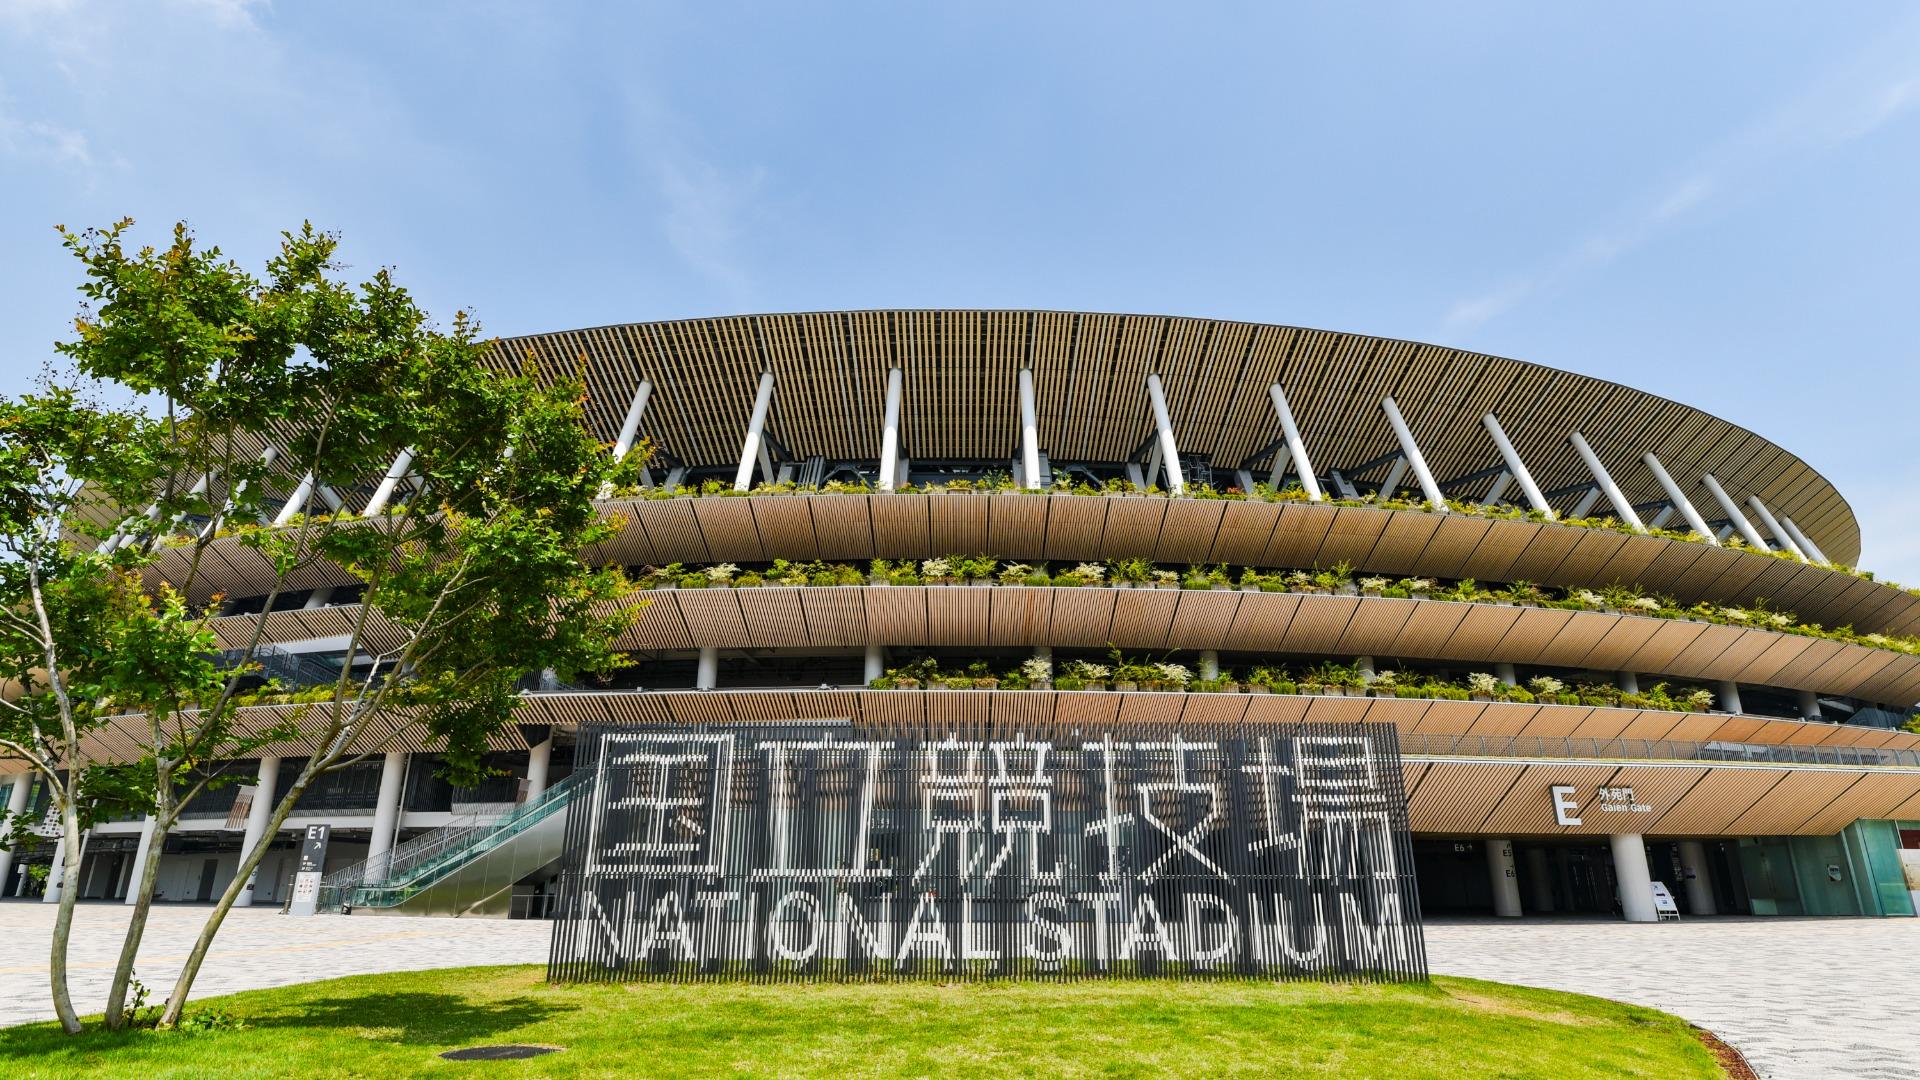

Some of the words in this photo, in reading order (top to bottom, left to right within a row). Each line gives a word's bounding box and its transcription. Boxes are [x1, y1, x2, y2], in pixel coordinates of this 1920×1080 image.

[1599, 787, 1635, 801] 外苑門
[1552, 785, 1582, 825] E
[1601, 803, 1628, 812] Gaien
[1630, 803, 1652, 812] Gate
[307, 825, 326, 840] E1
[1454, 843, 1465, 852] E6
[575, 889, 1000, 968] NATIONAL
[1024, 889, 1408, 970] STADIUM
